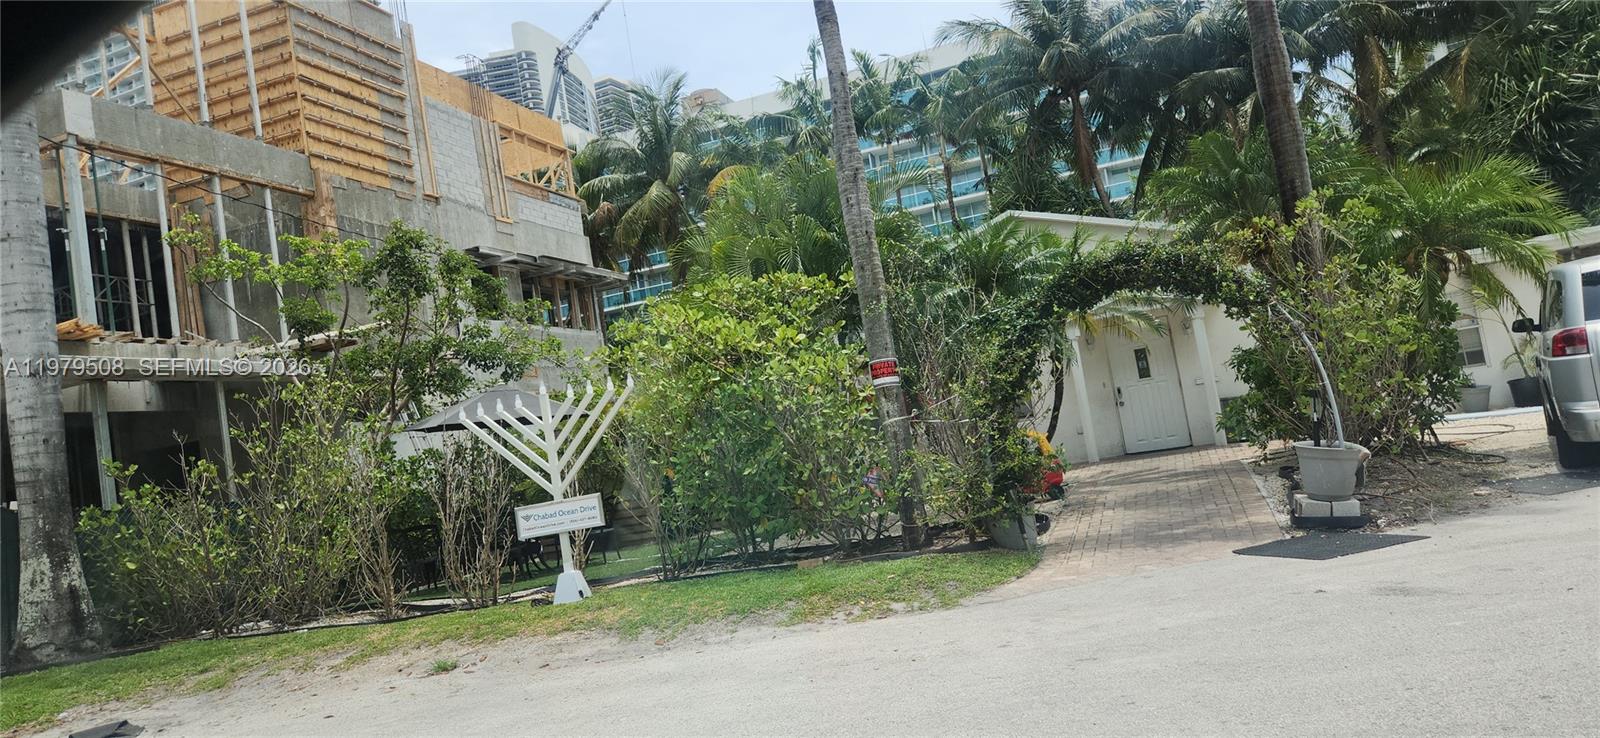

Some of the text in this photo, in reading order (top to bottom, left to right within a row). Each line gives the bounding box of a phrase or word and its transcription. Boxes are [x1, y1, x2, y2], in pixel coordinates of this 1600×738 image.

[533, 504, 597, 521] Chabad Ocean Drive
